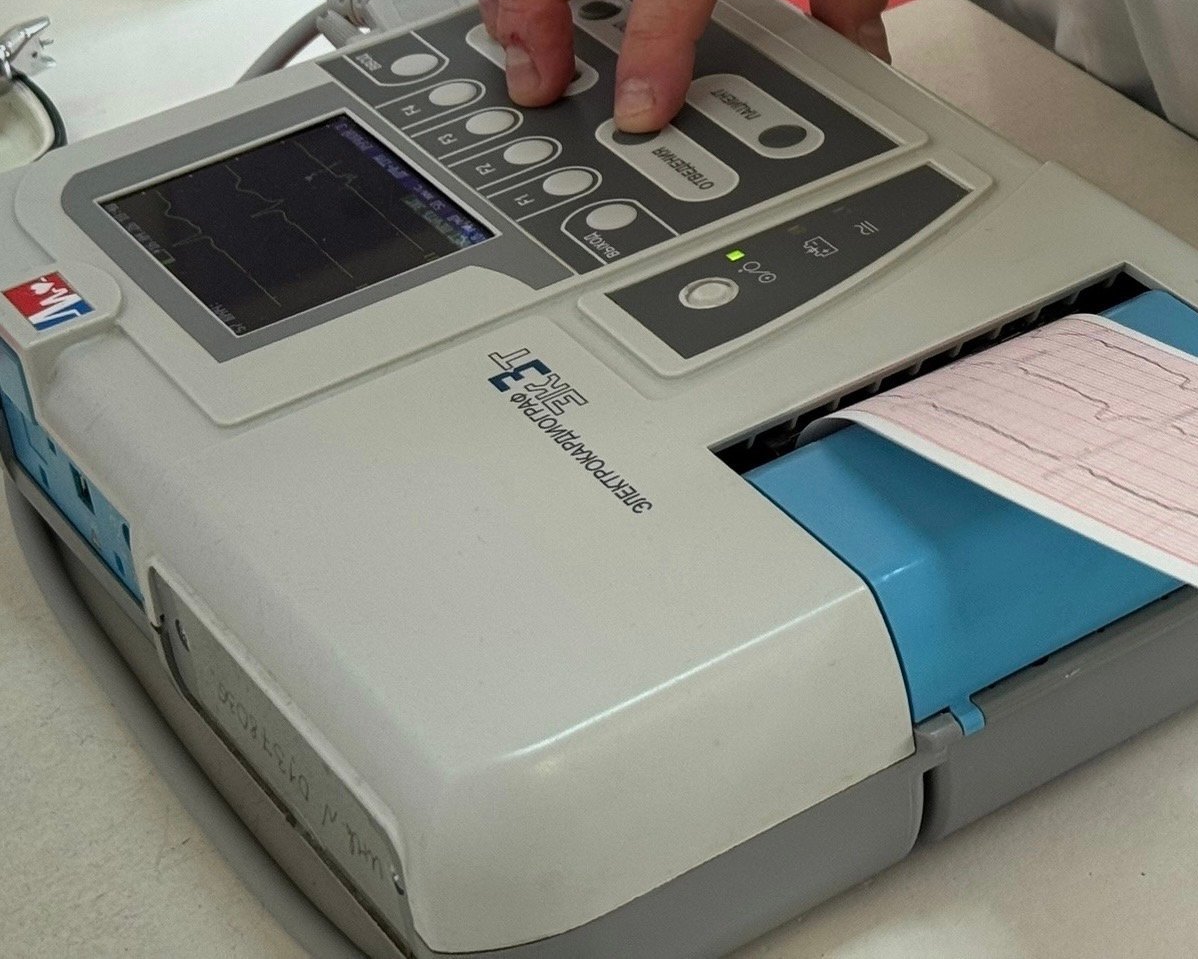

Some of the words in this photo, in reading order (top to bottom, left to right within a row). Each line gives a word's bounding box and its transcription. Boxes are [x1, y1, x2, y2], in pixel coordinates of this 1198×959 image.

[401, 104, 421, 117] F4
[710, 88, 761, 121] ПАЦИЕНТ
[437, 133, 458, 145] F3
[475, 162, 496, 176] F2
[652, 146, 715, 190] ОТВЕДЕНИЯ
[514, 194, 535, 207] F1
[583, 231, 620, 259] ВЫХОД
[510, 393, 653, 514] ЭЛЕКТРОКАРДИОГРАФ
